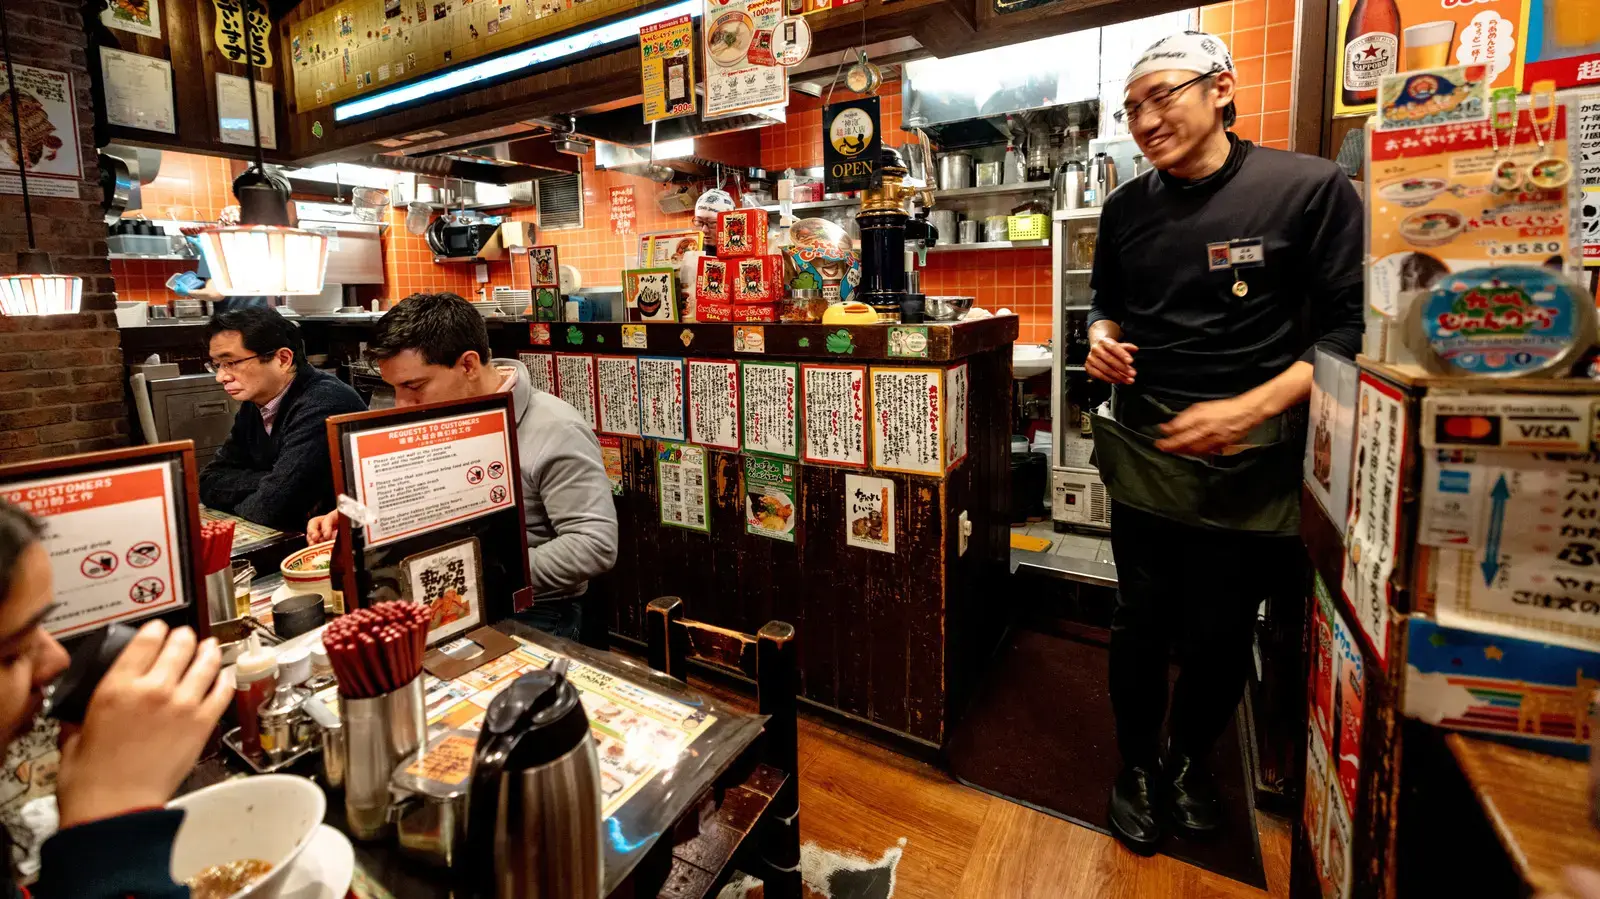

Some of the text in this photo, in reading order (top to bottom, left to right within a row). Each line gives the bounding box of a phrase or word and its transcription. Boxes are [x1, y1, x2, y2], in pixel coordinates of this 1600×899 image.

[1354, 60, 1388, 71] SAPPORO
[832, 160, 874, 178] OPEN
[388, 426, 427, 439] REQUESTS
[440, 418, 480, 430] CUSTOMERS
[1518, 424, 1571, 438] VISA
[27, 478, 113, 500] CUSTOMERS
